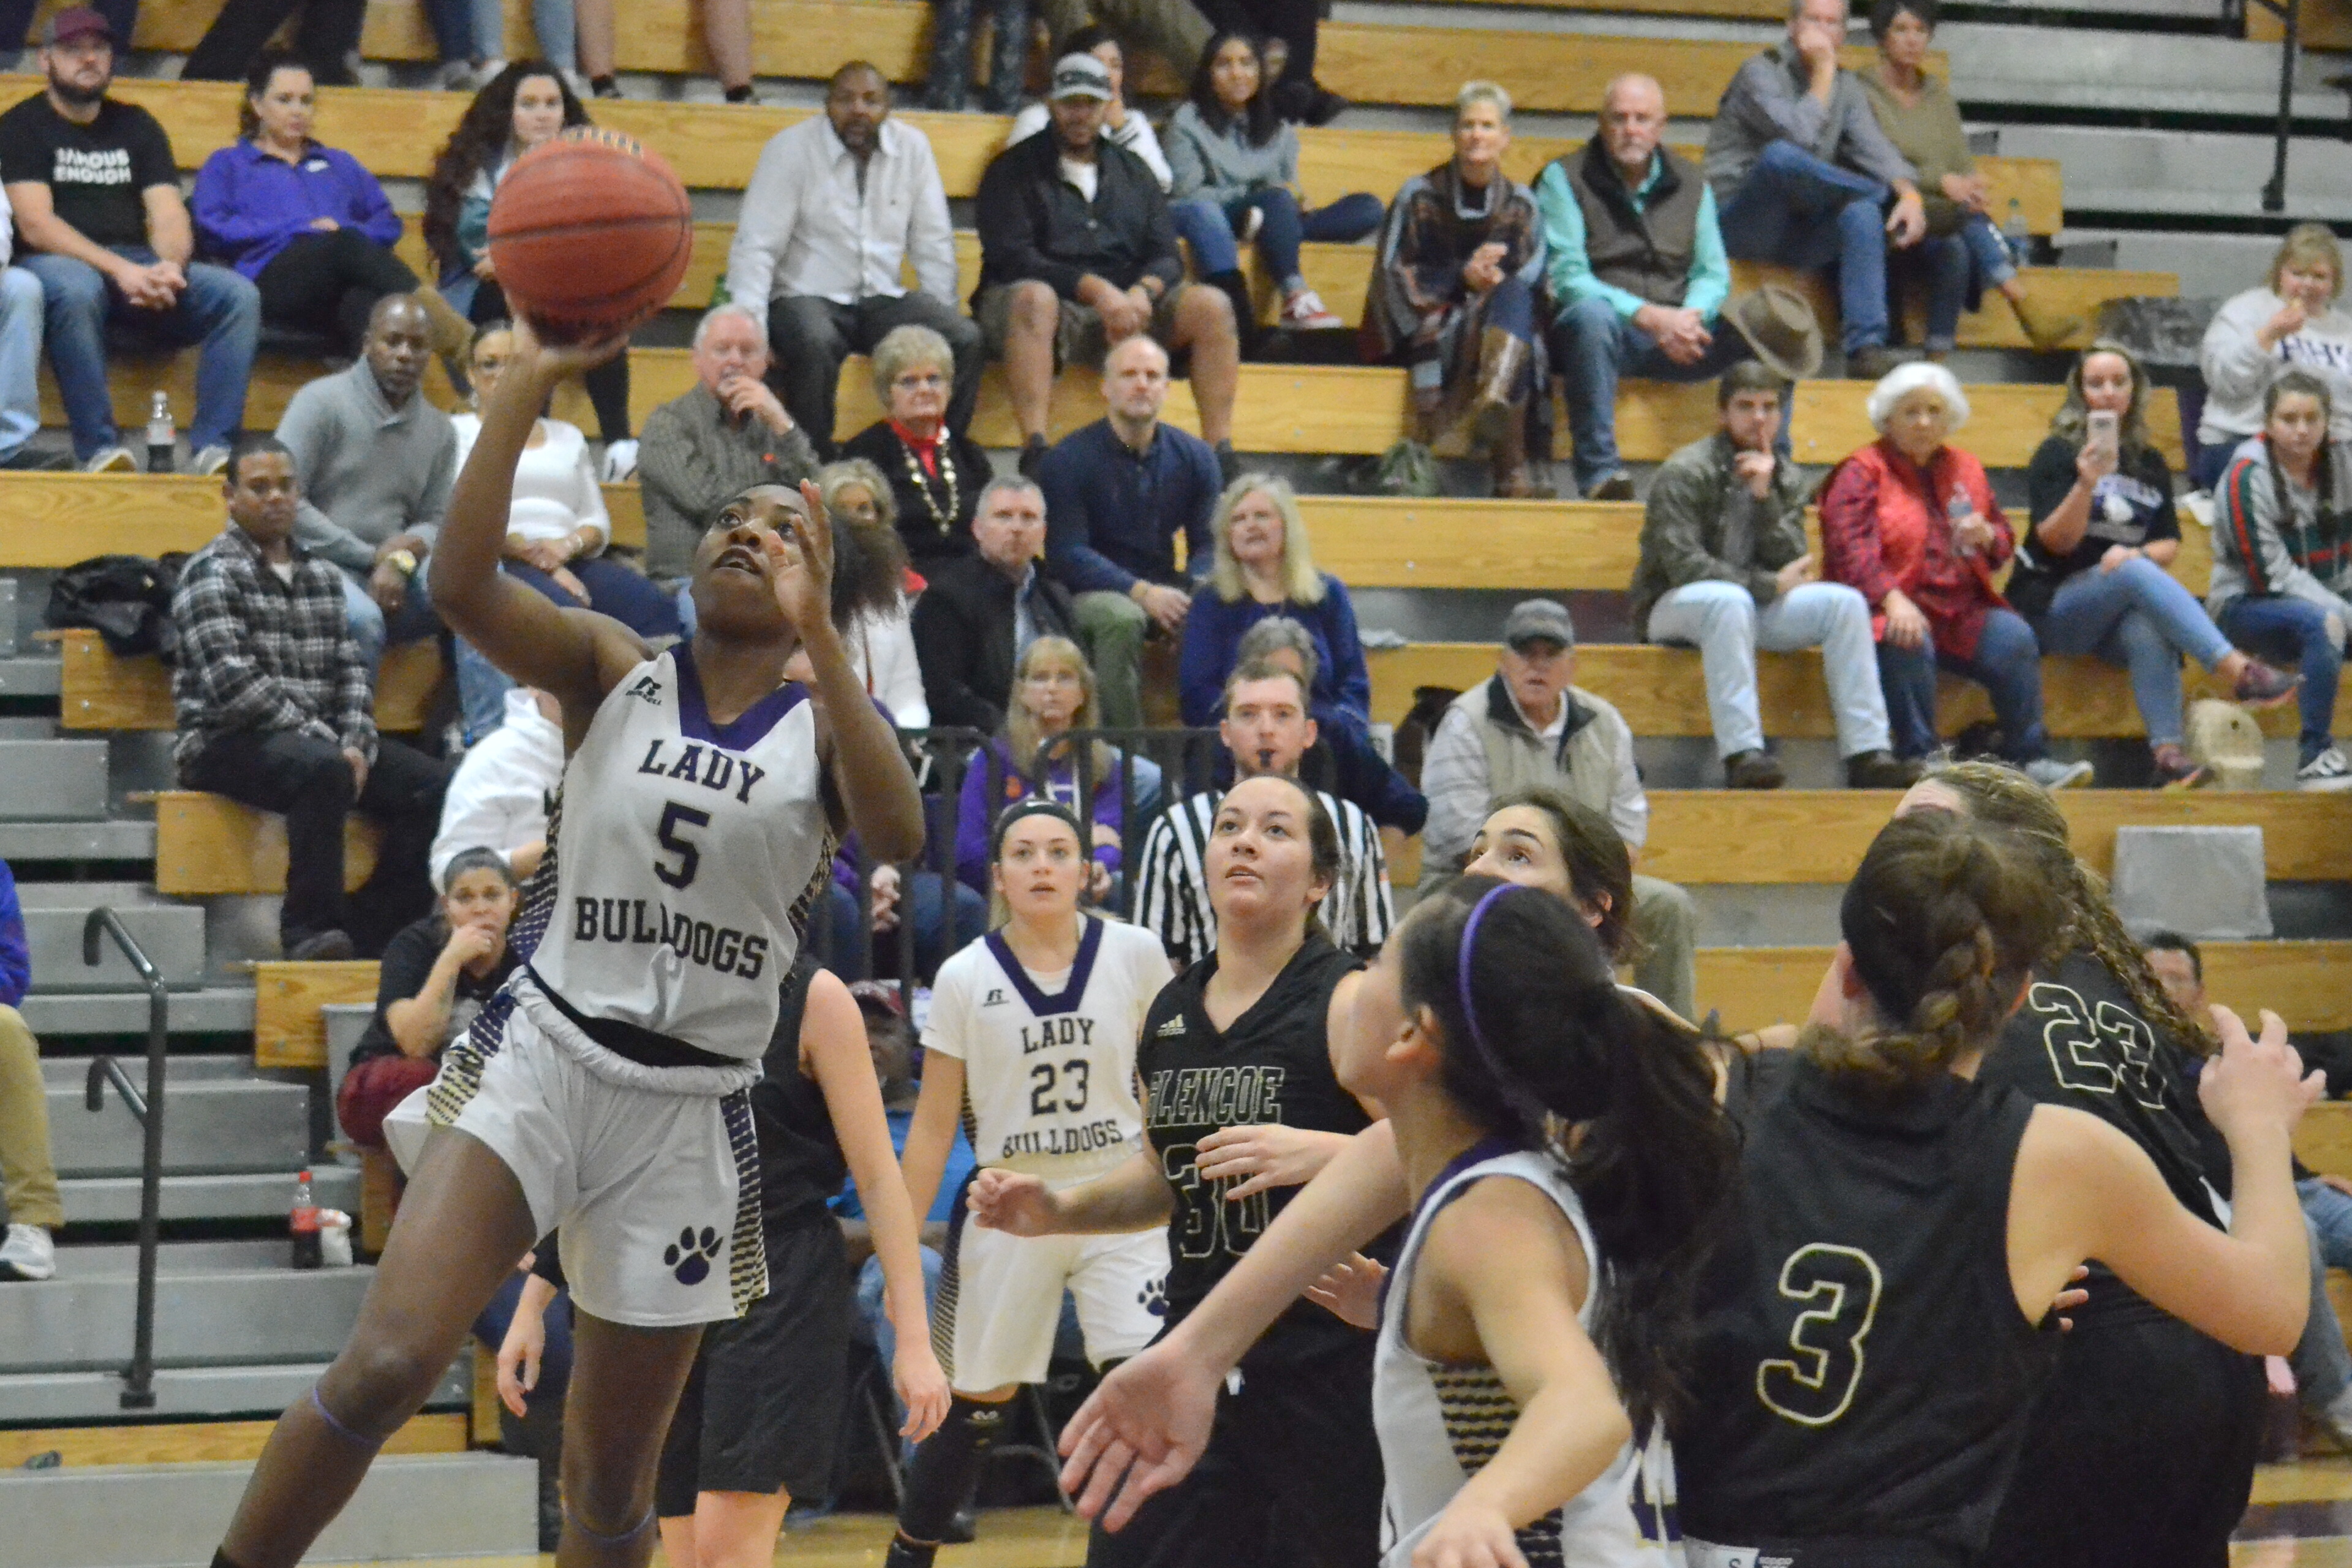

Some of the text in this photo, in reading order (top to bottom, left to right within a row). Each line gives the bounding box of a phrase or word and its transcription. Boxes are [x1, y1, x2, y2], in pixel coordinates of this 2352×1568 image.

[638, 739, 765, 805] LADY
[654, 800, 712, 891] 5
[575, 896, 769, 980] BULLDOGS
[1021, 1017, 1095, 1054] LADY
[2029, 982, 2168, 1110] 23
[1031, 1059, 1089, 1116] 23
[1002, 1119, 1123, 1159] BULLDOGS
[1757, 1242, 1882, 1425] 3
